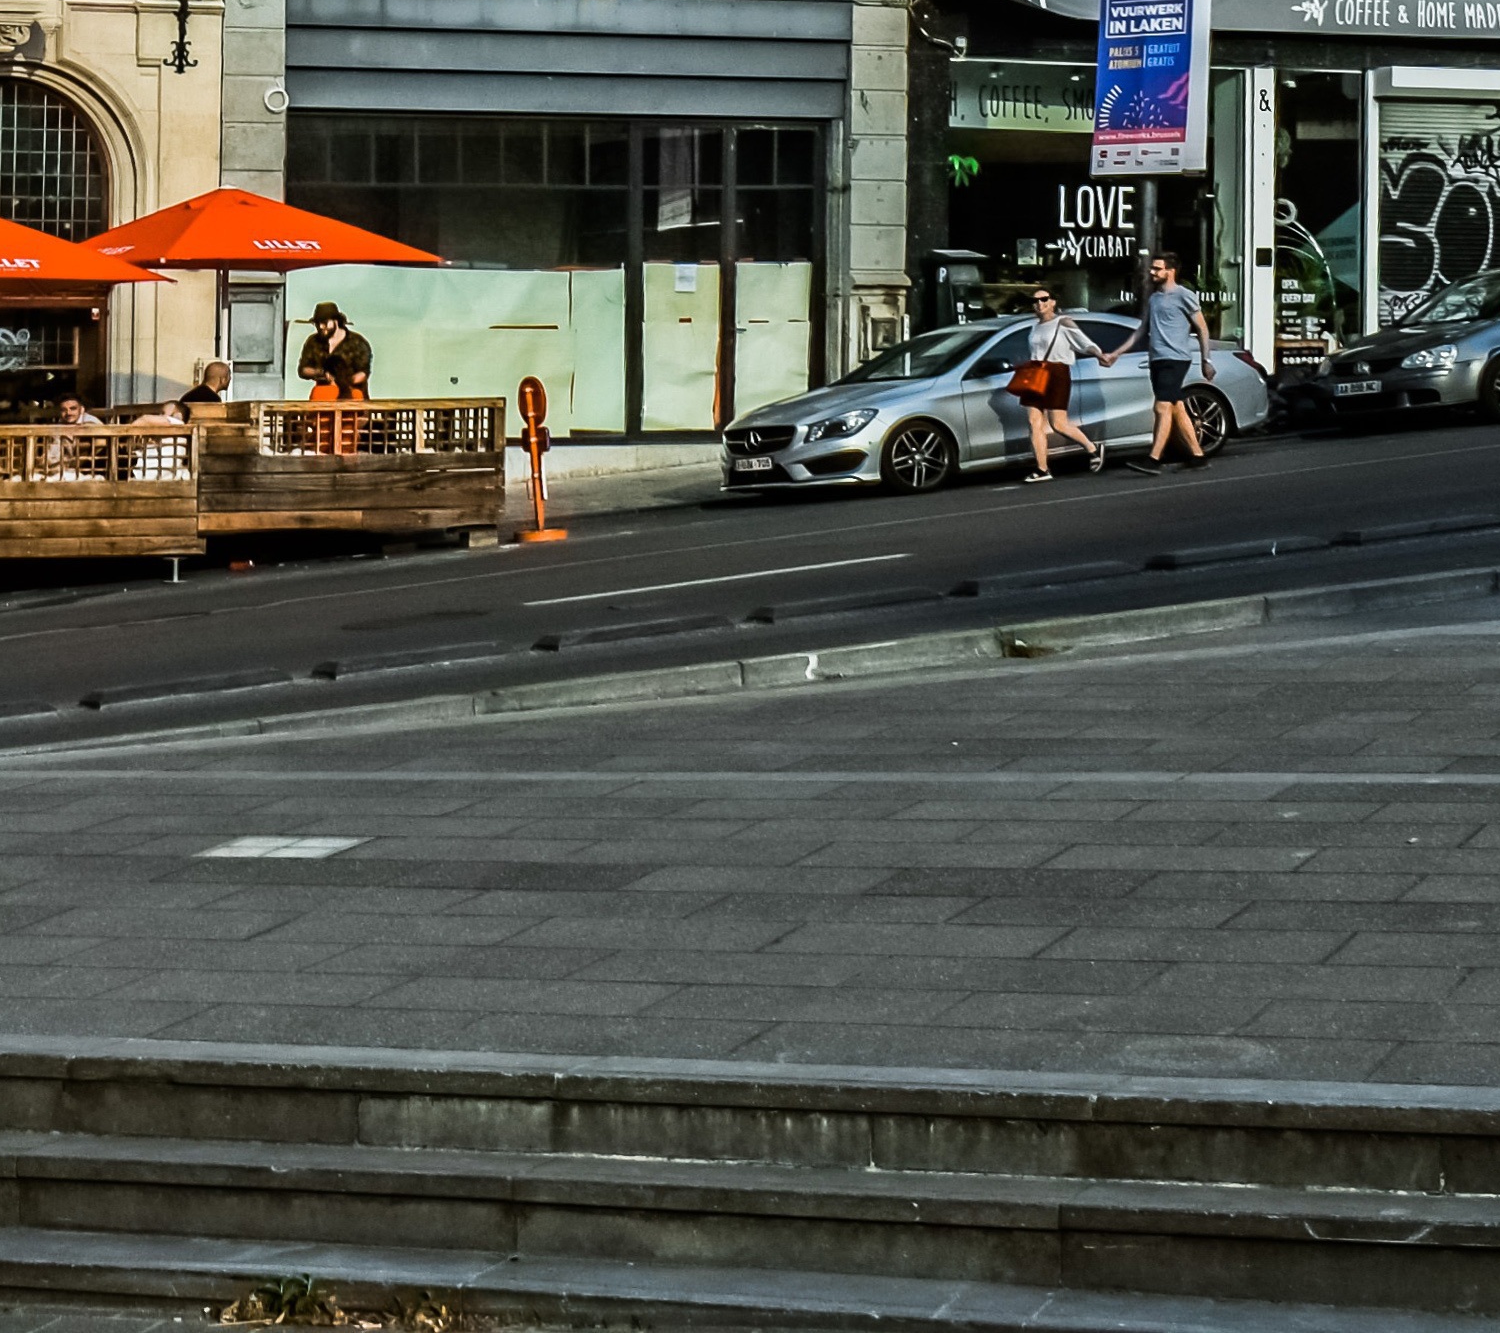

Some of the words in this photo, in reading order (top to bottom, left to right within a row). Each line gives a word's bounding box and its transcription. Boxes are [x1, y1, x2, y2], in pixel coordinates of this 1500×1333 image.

[1111, 3, 1183, 18] VUURWERK
[1397, 3, 1410, 24] &
[1417, 0, 1457, 29] HOME
[1109, 20, 1127, 34] IN
[1130, 17, 1183, 33] LAKEN
[1059, 184, 1136, 229] LOVE
[252, 239, 322, 251] LILLET
